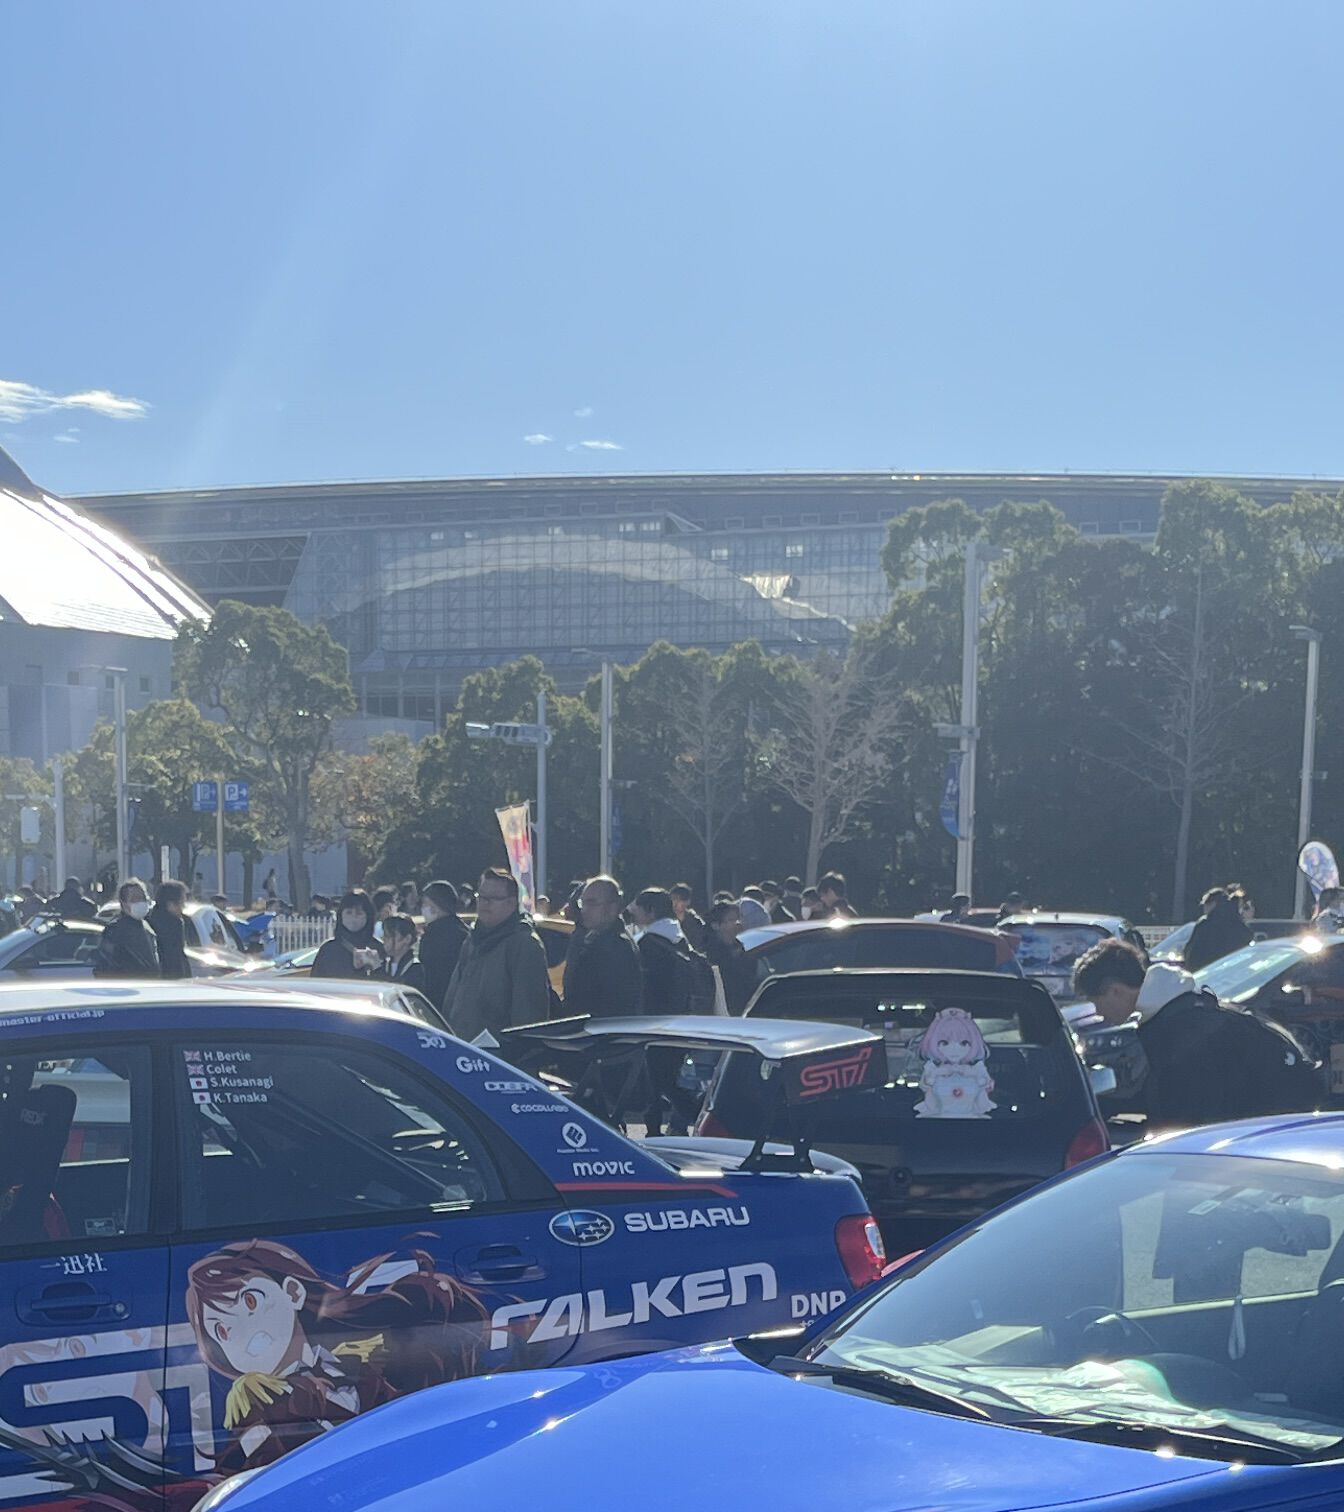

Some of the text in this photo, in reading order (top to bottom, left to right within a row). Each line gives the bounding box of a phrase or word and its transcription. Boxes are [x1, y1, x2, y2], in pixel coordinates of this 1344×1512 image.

[204, 1050, 251, 1061] H.Bertie
[206, 1064, 238, 1074] Colet
[456, 1056, 490, 1073] Gift
[211, 1076, 273, 1089] S.Kusanagi
[213, 1092, 267, 1103] K.Tanaka
[623, 1206, 749, 1233] SUBARU
[40, 1253, 108, 1275] 一迅社
[490, 1262, 777, 1352] FALKEN
